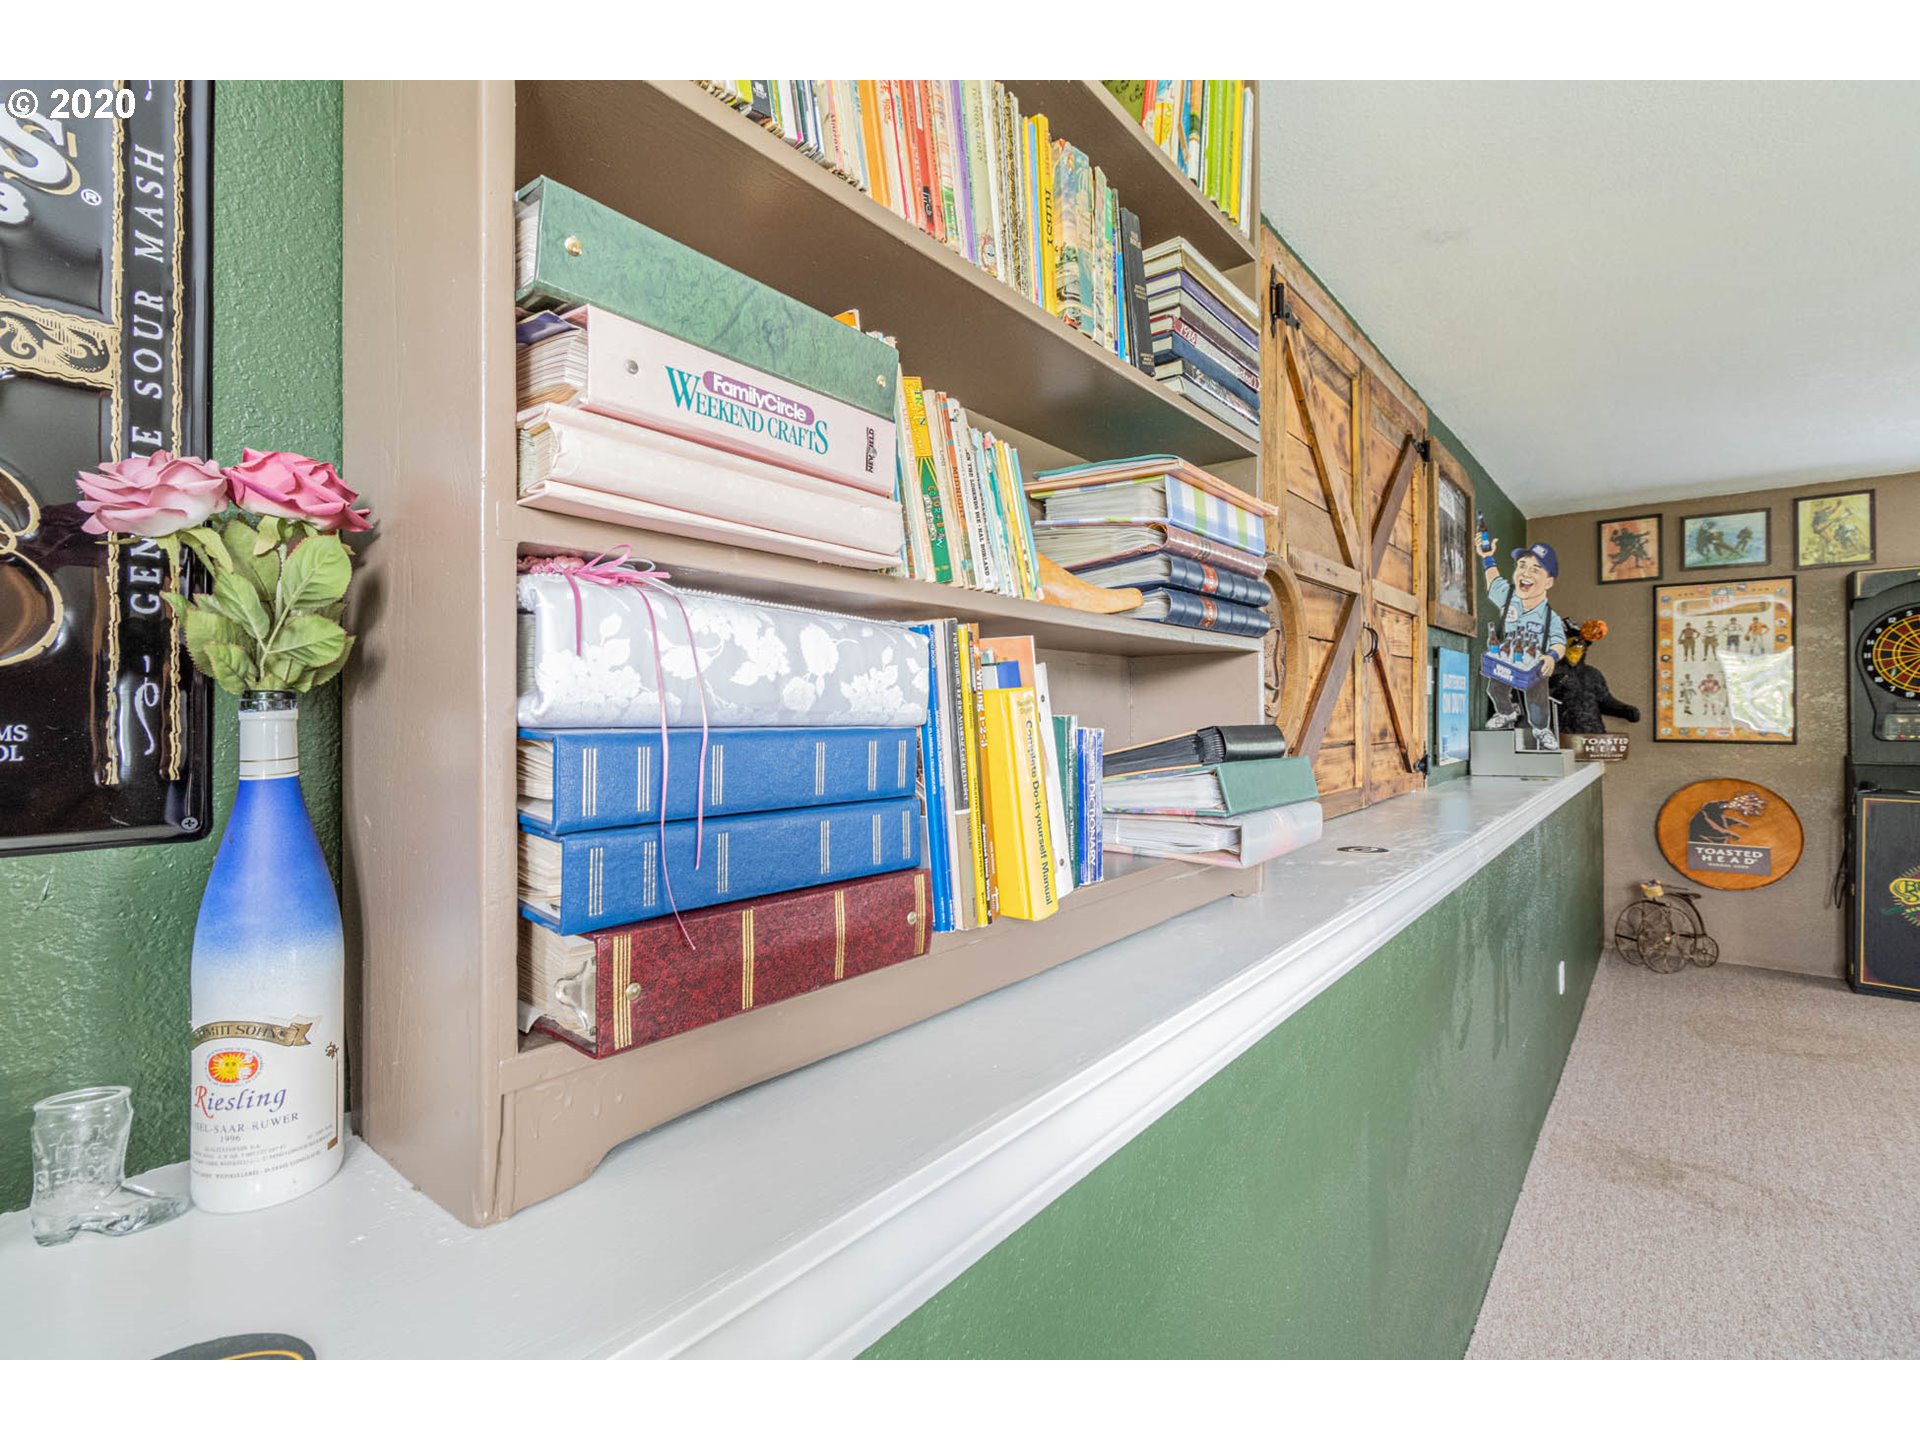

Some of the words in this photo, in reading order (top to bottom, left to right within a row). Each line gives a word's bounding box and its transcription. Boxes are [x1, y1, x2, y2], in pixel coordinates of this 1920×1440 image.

[134, 144, 165, 263] MASH
[133, 290, 164, 400] SOUR
[665, 365, 765, 433] WEEKEND
[767, 417, 829, 456] CRAFTS
[975, 669, 985, 711] Wiring
[978, 715, 988, 748] 1-2-3
[1580, 737, 1629, 745] TOASTED
[1024, 719, 1038, 778] Complete
[1032, 781, 1047, 859] Do-it-yourself
[1041, 862, 1053, 906] Manual
[1088, 783, 1096, 866] DICTIONARY
[1695, 846, 1763, 858] TOASTED
[1701, 854, 1755, 865] HEAD
[193, 1085, 287, 1119] Riesling
